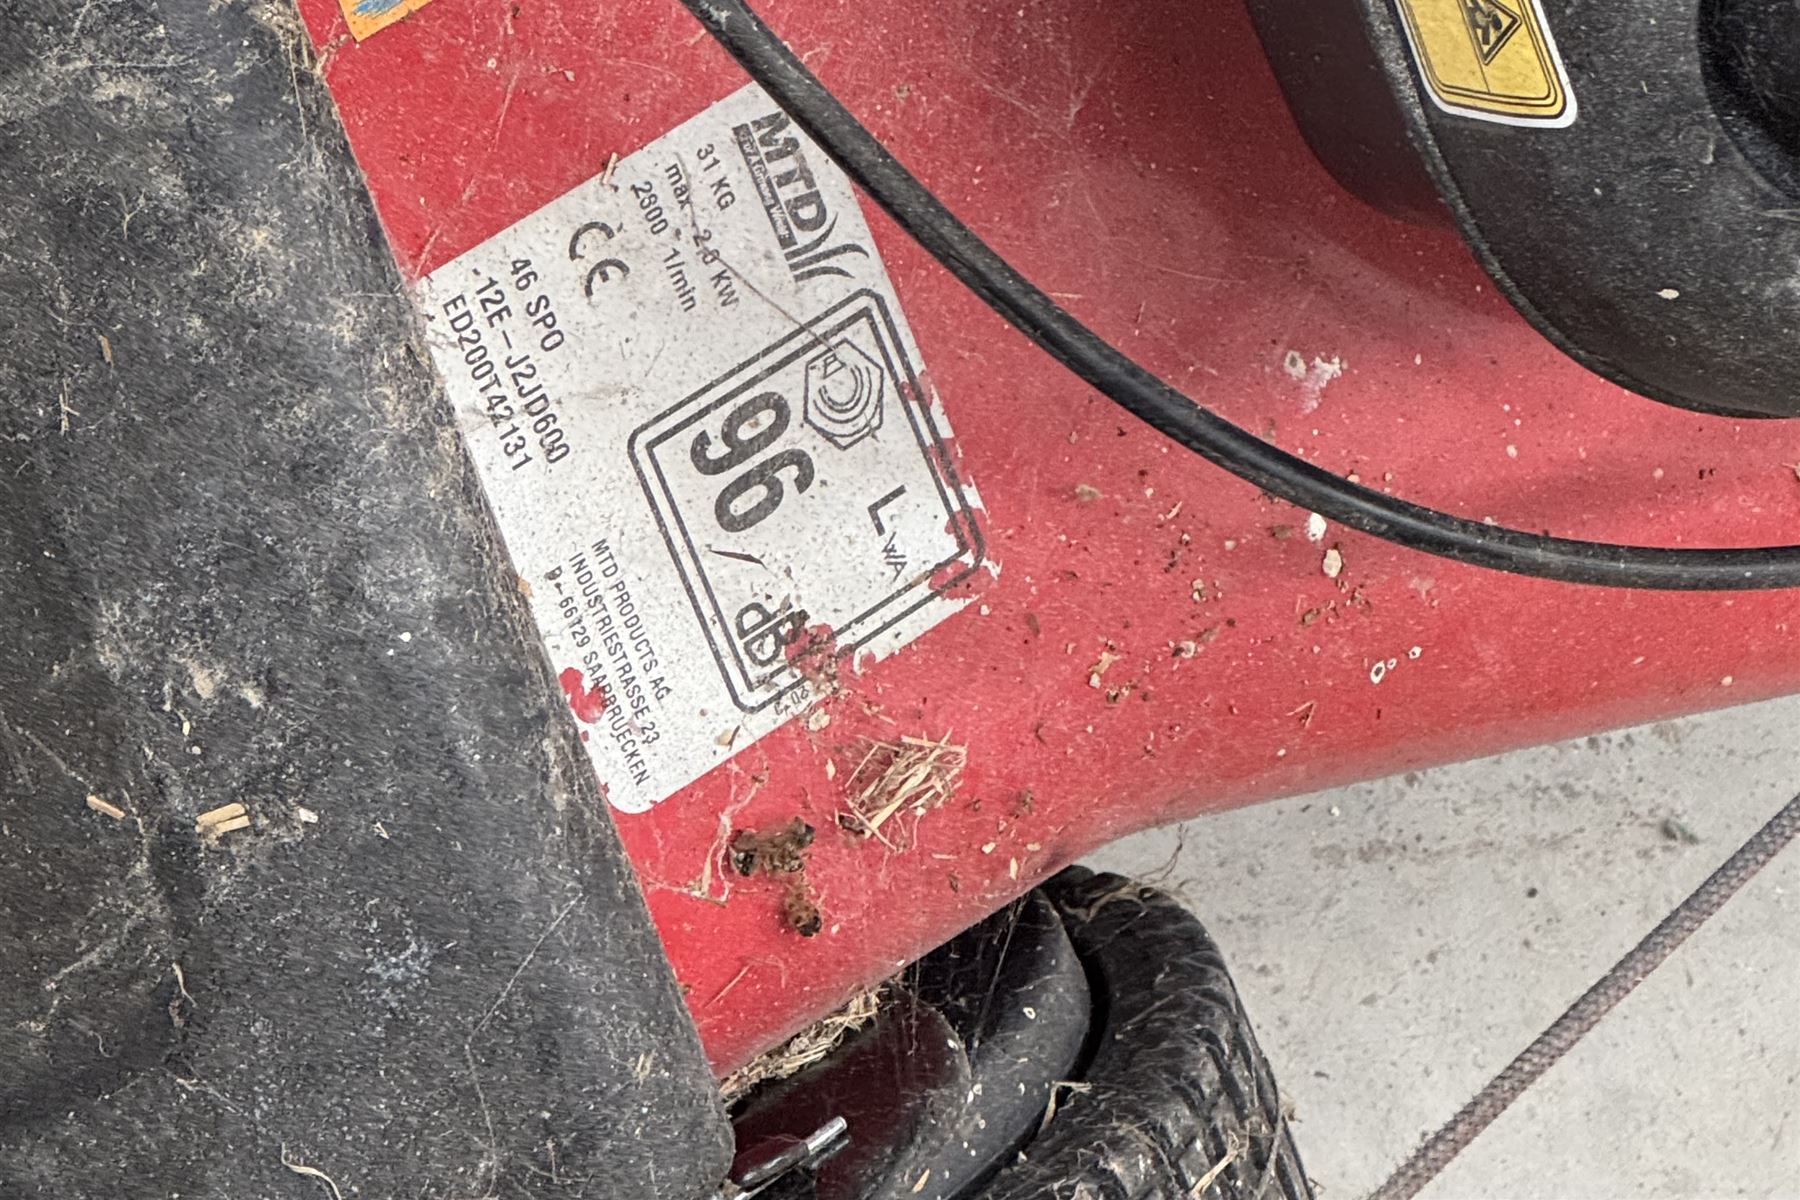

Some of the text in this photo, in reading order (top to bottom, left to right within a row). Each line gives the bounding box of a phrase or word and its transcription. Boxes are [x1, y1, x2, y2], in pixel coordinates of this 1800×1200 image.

[697, 143, 736, 211] 31 KG
[751, 111, 827, 231] MTD
[511, 259, 538, 291] 46
[664, 248, 697, 313] 1/min
[710, 269, 740, 308] KW
[443, 294, 533, 471] ED200T42131
[690, 391, 815, 533] 96
[569, 552, 660, 745] INDUSTRIESTRASSE 23
[591, 538, 671, 701] MTD PRODUCTS AG
[583, 650, 650, 786] SAARBRUECKEN
